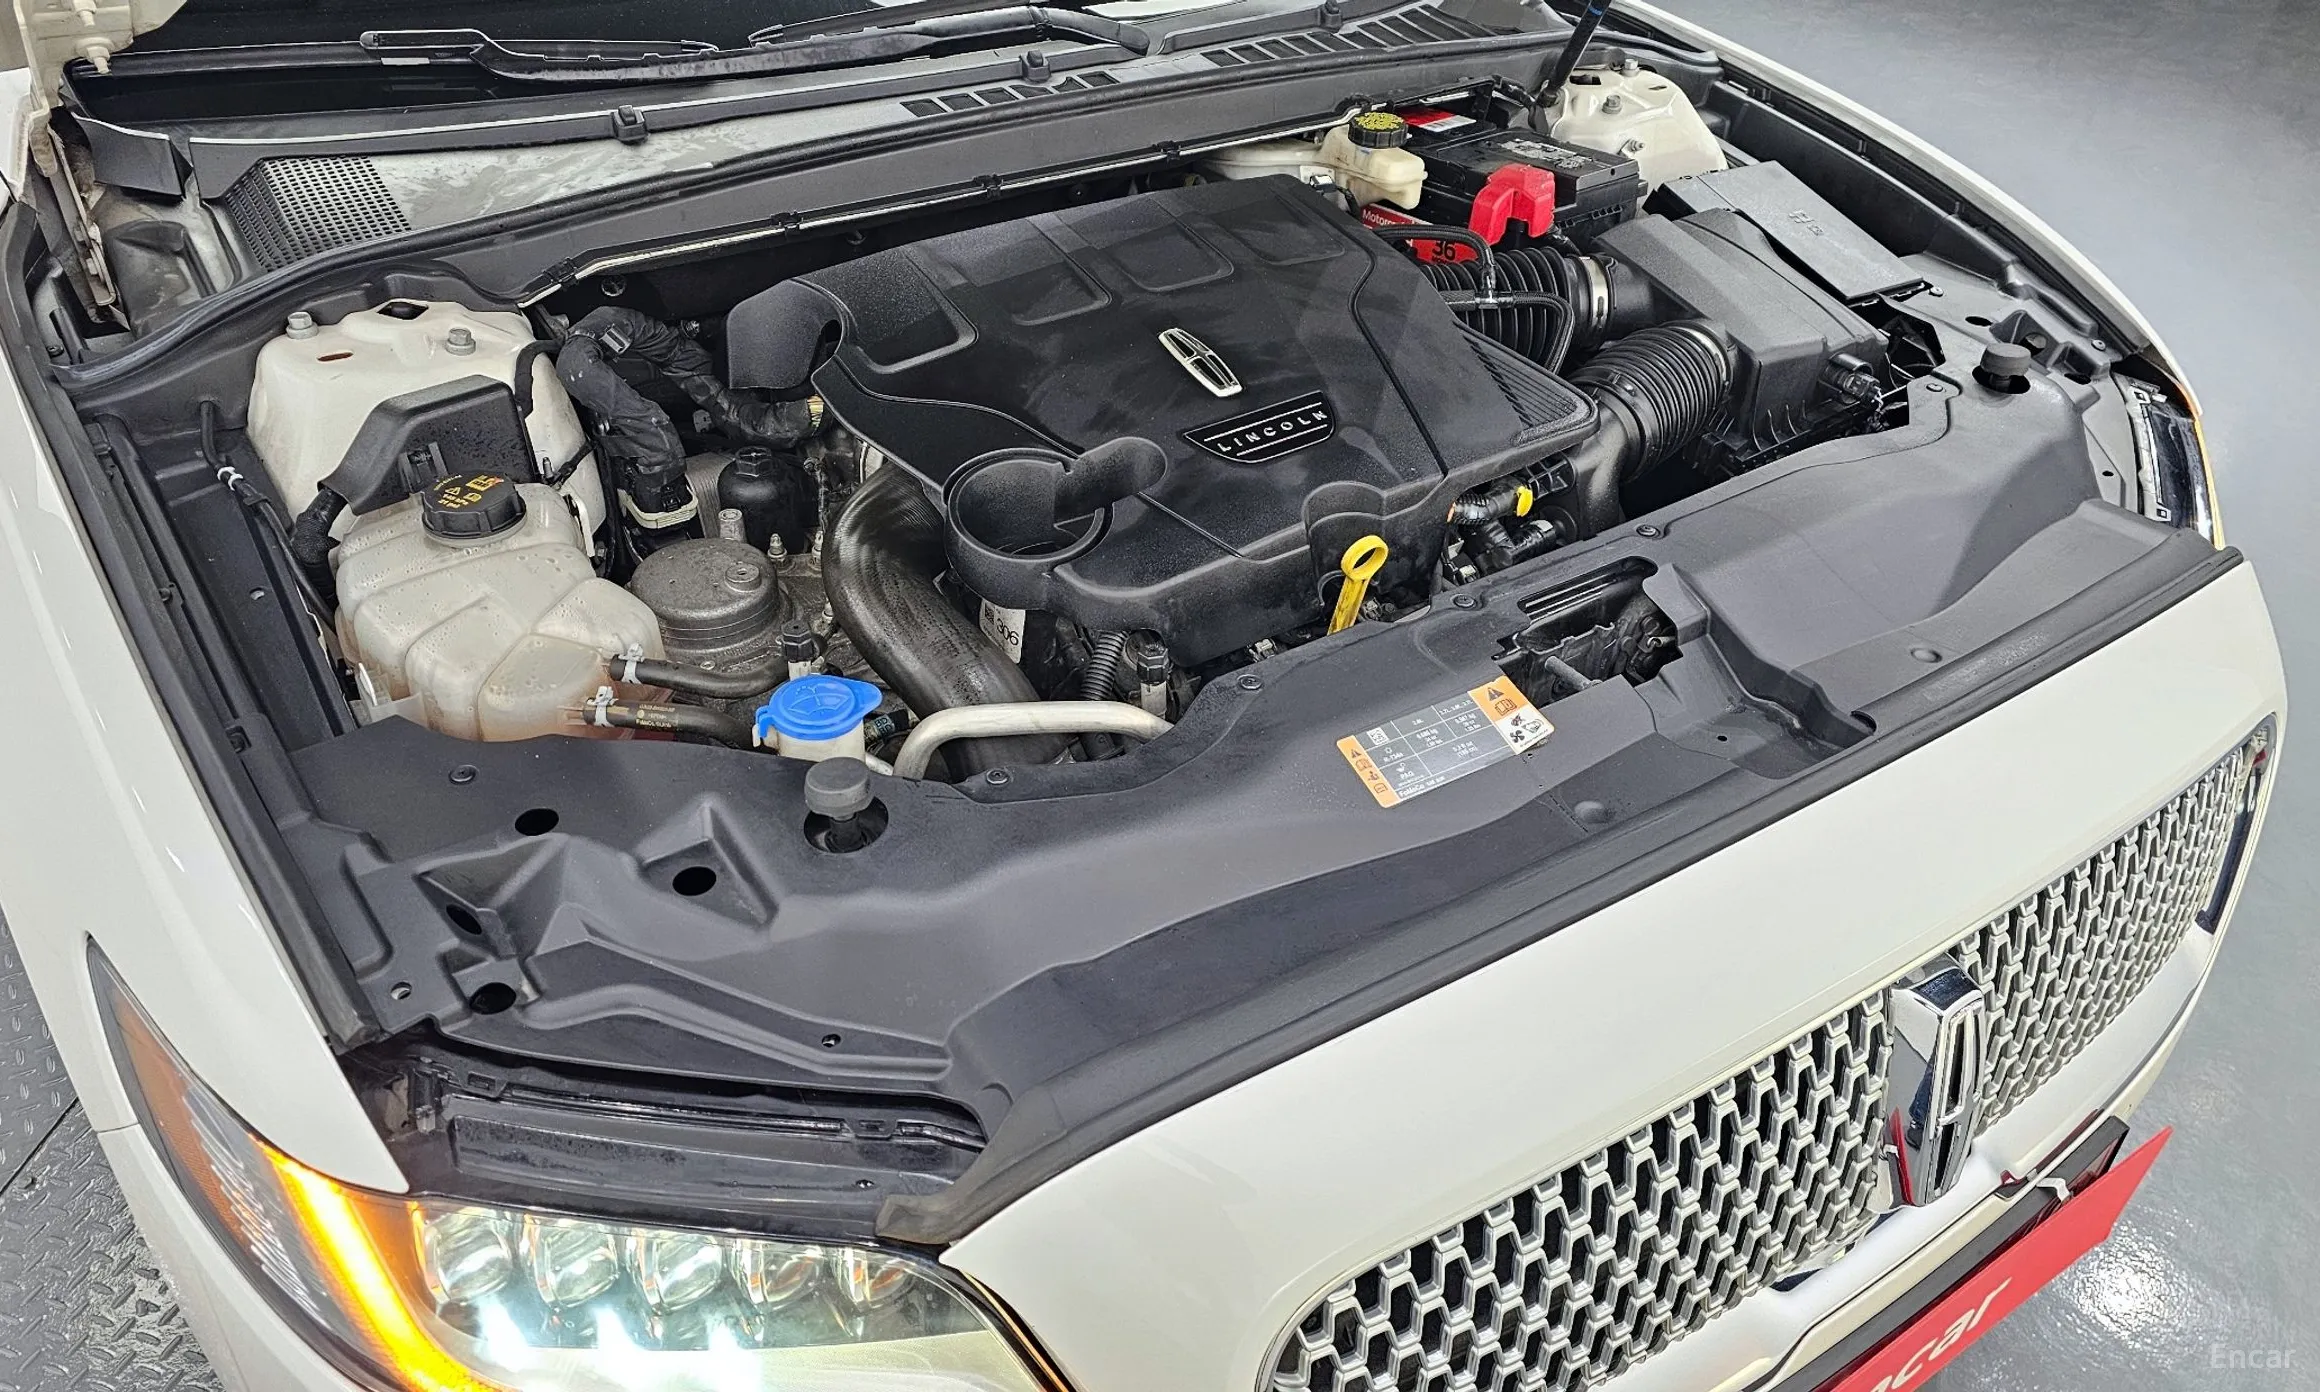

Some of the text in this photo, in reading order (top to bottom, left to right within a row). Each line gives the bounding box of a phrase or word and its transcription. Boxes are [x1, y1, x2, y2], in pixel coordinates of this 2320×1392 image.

[1432, 239, 1456, 260] 36
[1217, 411, 1328, 452] LINCOLN
[996, 617, 1020, 646] 306
